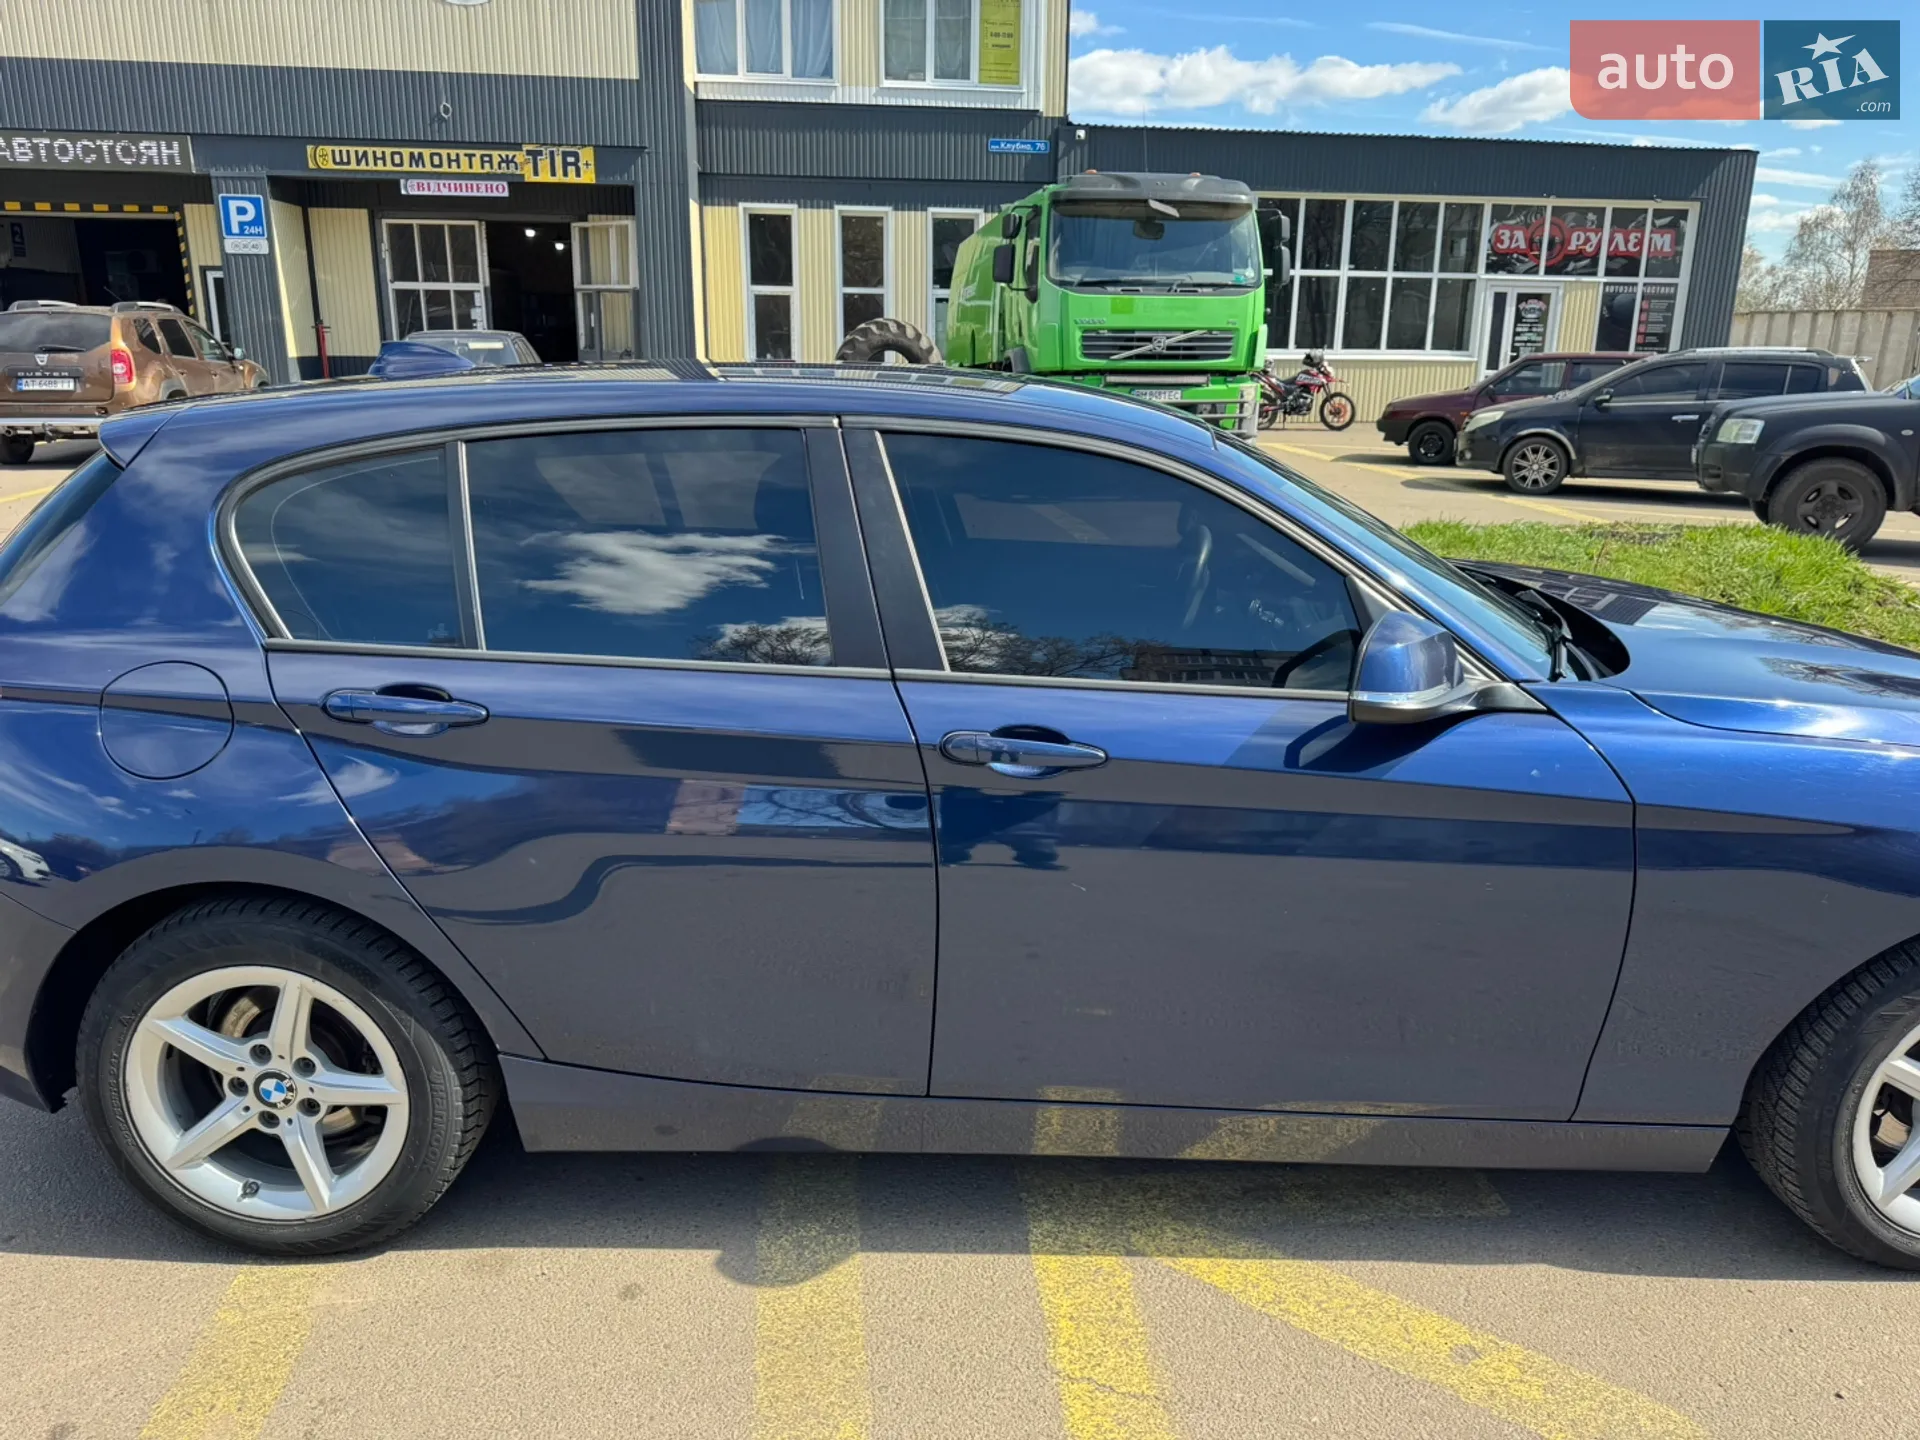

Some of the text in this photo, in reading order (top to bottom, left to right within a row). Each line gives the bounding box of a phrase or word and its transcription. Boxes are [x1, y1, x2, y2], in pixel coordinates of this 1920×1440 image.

[331, 148, 519, 173] ШИНОМОНТАЖ
[416, 181, 507, 195] ВІДЧИНЕНО
[228, 200, 256, 234] P
[243, 225, 263, 234] 24H
[1496, 229, 1672, 252] ЗА РУЛЕМ
[276, 1079, 295, 1109] BMW
